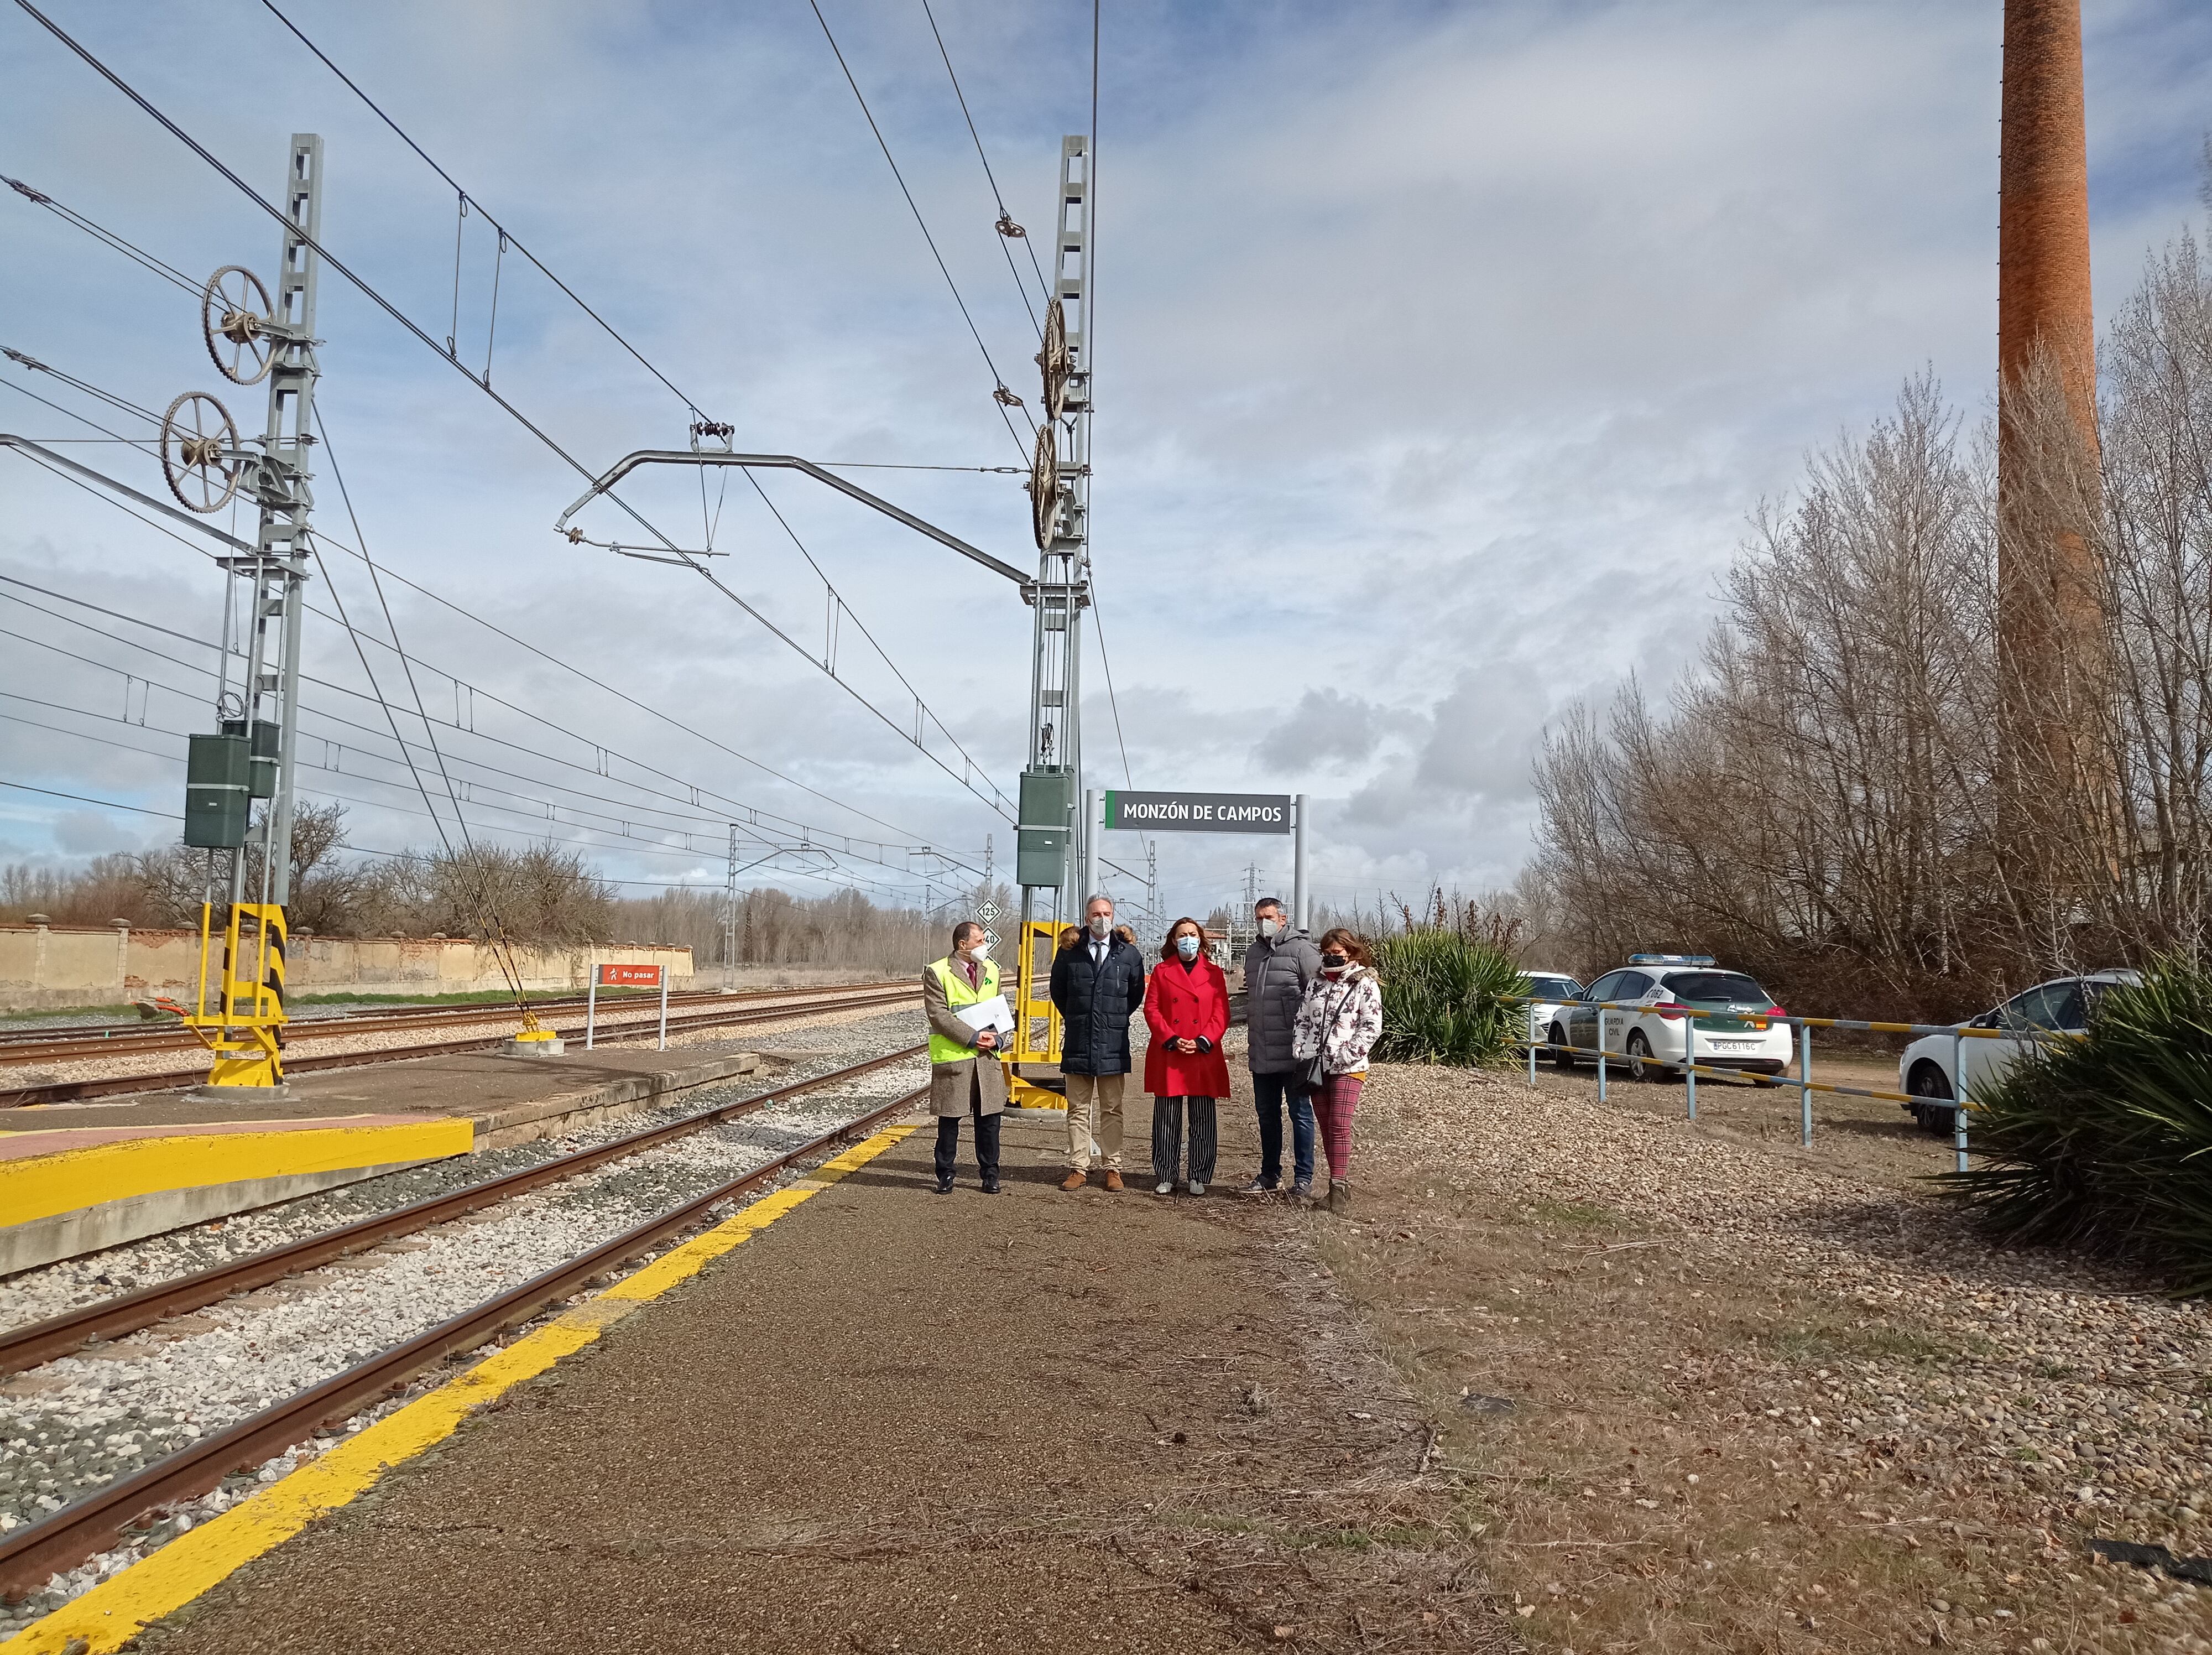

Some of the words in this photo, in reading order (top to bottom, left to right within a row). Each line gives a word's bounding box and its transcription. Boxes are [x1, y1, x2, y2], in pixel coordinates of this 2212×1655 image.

[1124, 801, 1189, 819] MONZÓN
[1193, 805, 1213, 820] DE
[1217, 805, 1282, 823] CAMPOS
[1651, 989, 1664, 998] 062
